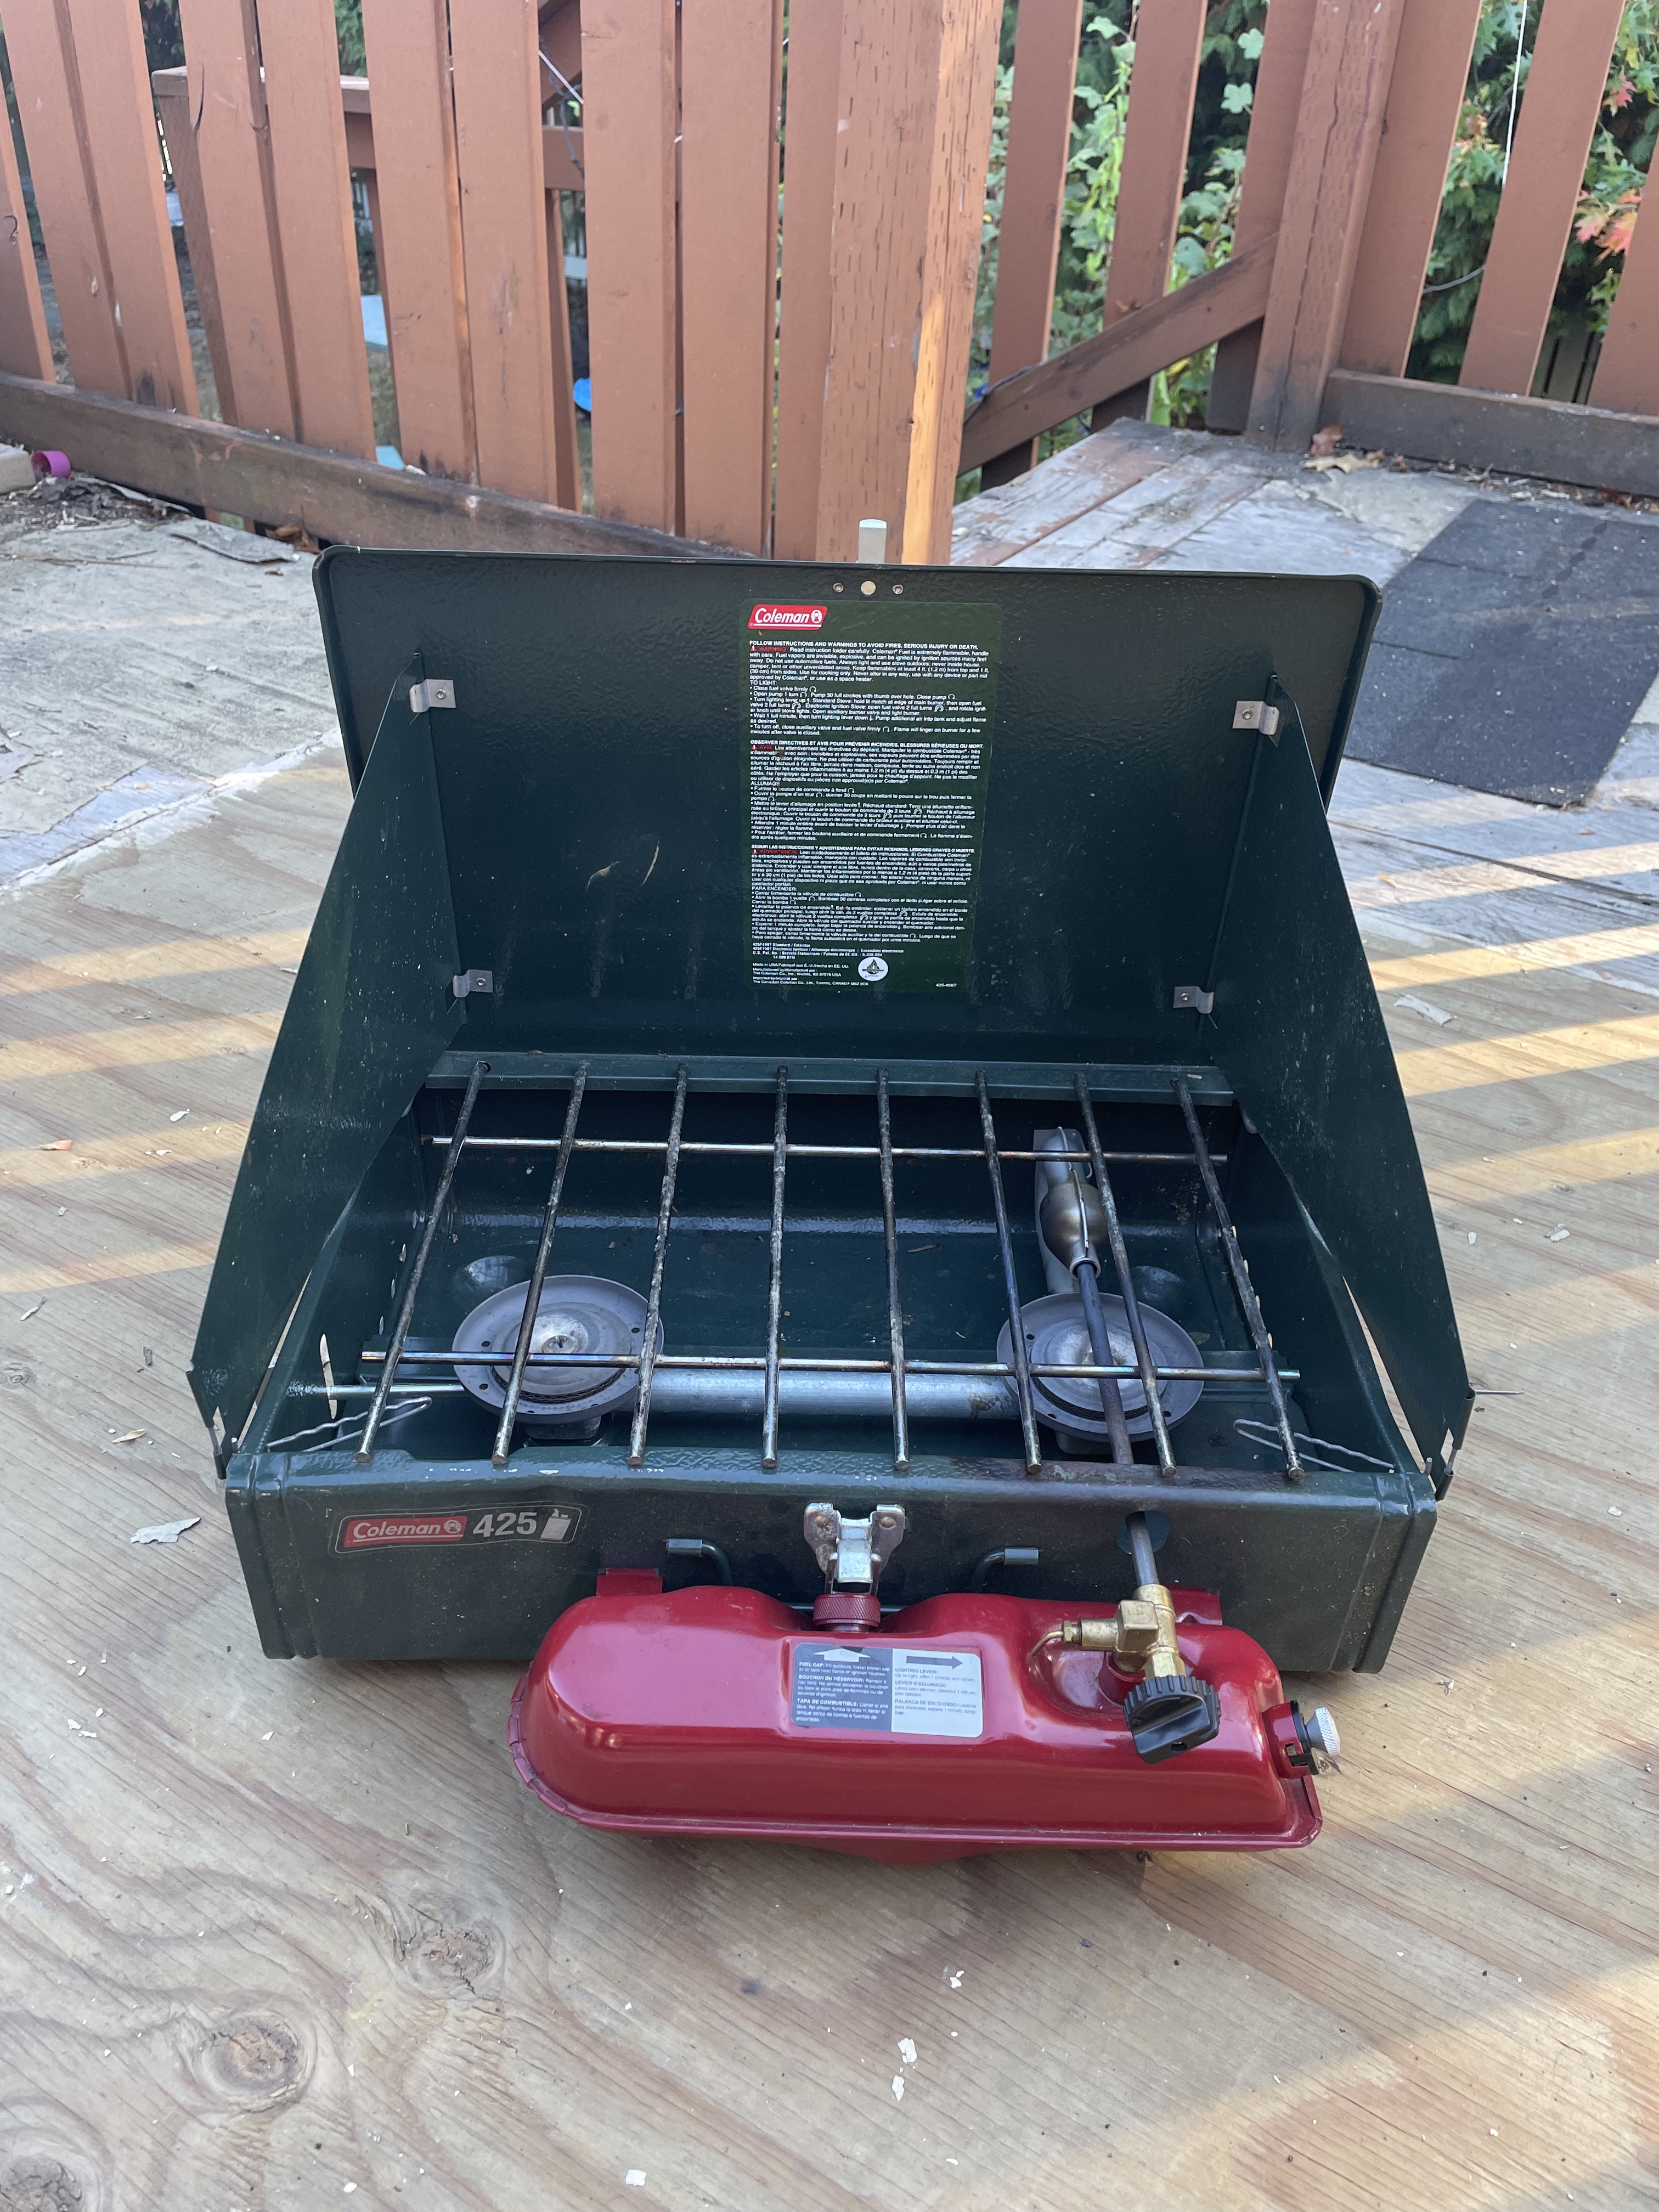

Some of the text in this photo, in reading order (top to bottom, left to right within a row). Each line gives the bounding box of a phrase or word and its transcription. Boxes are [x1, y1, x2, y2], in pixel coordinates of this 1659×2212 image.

[754, 607, 810, 624] Coleman
[353, 1511, 538, 1539] Coleman 425
